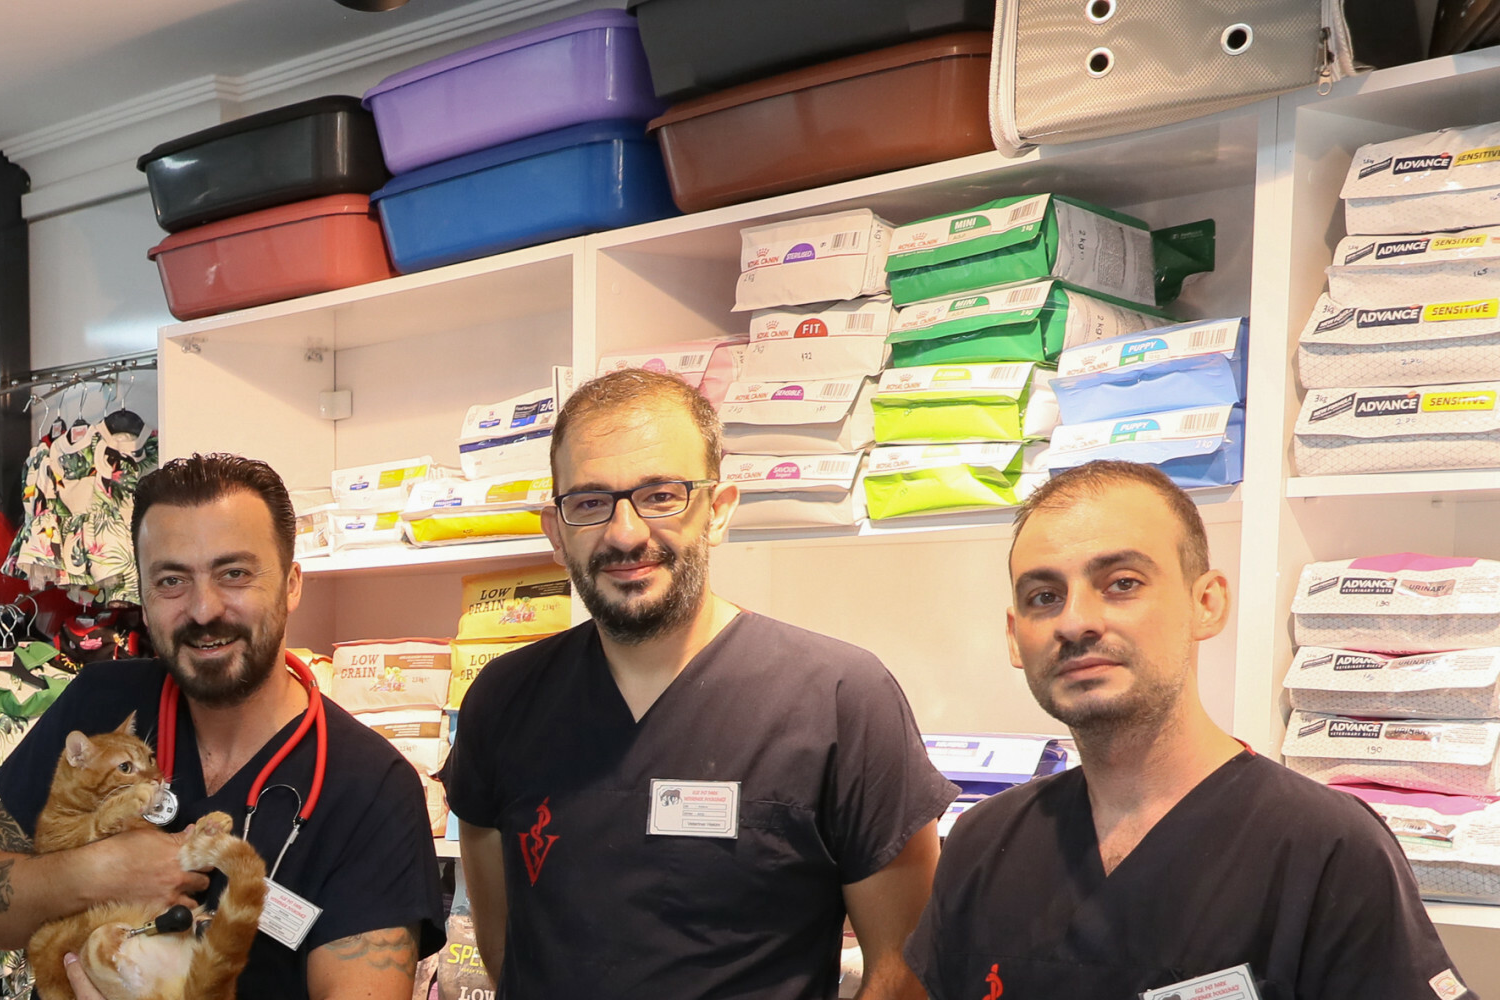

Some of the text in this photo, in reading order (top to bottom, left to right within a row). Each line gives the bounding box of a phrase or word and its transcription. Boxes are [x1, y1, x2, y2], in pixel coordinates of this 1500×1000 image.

[1395, 158, 1450, 171] ADVANCE
[954, 217, 977, 230] MINI
[898, 242, 916, 250] ROYAL
[1378, 237, 1482, 256] ADVANCE SENSITIVE
[761, 256, 779, 264] CANIN
[955, 298, 978, 309] MINI
[1359, 309, 1419, 323] ADVANCE
[1431, 303, 1489, 316] SENSITIVE
[802, 323, 821, 334] FIT
[1128, 341, 1157, 353] PUPPY
[1067, 368, 1085, 376] ROYAL
[1357, 398, 1417, 413] ADVANCE
[1429, 397, 1485, 407] SENSITIVE
[1120, 422, 1149, 432] PUPPY
[1343, 579, 1446, 593] ADVANCE URINARY
[480, 588, 511, 600] LOW
[469, 599, 506, 616] GRAIN
[351, 655, 379, 666] LOW
[340, 667, 377, 679] GRAIN
[1331, 723, 1381, 733] ADVANCE
